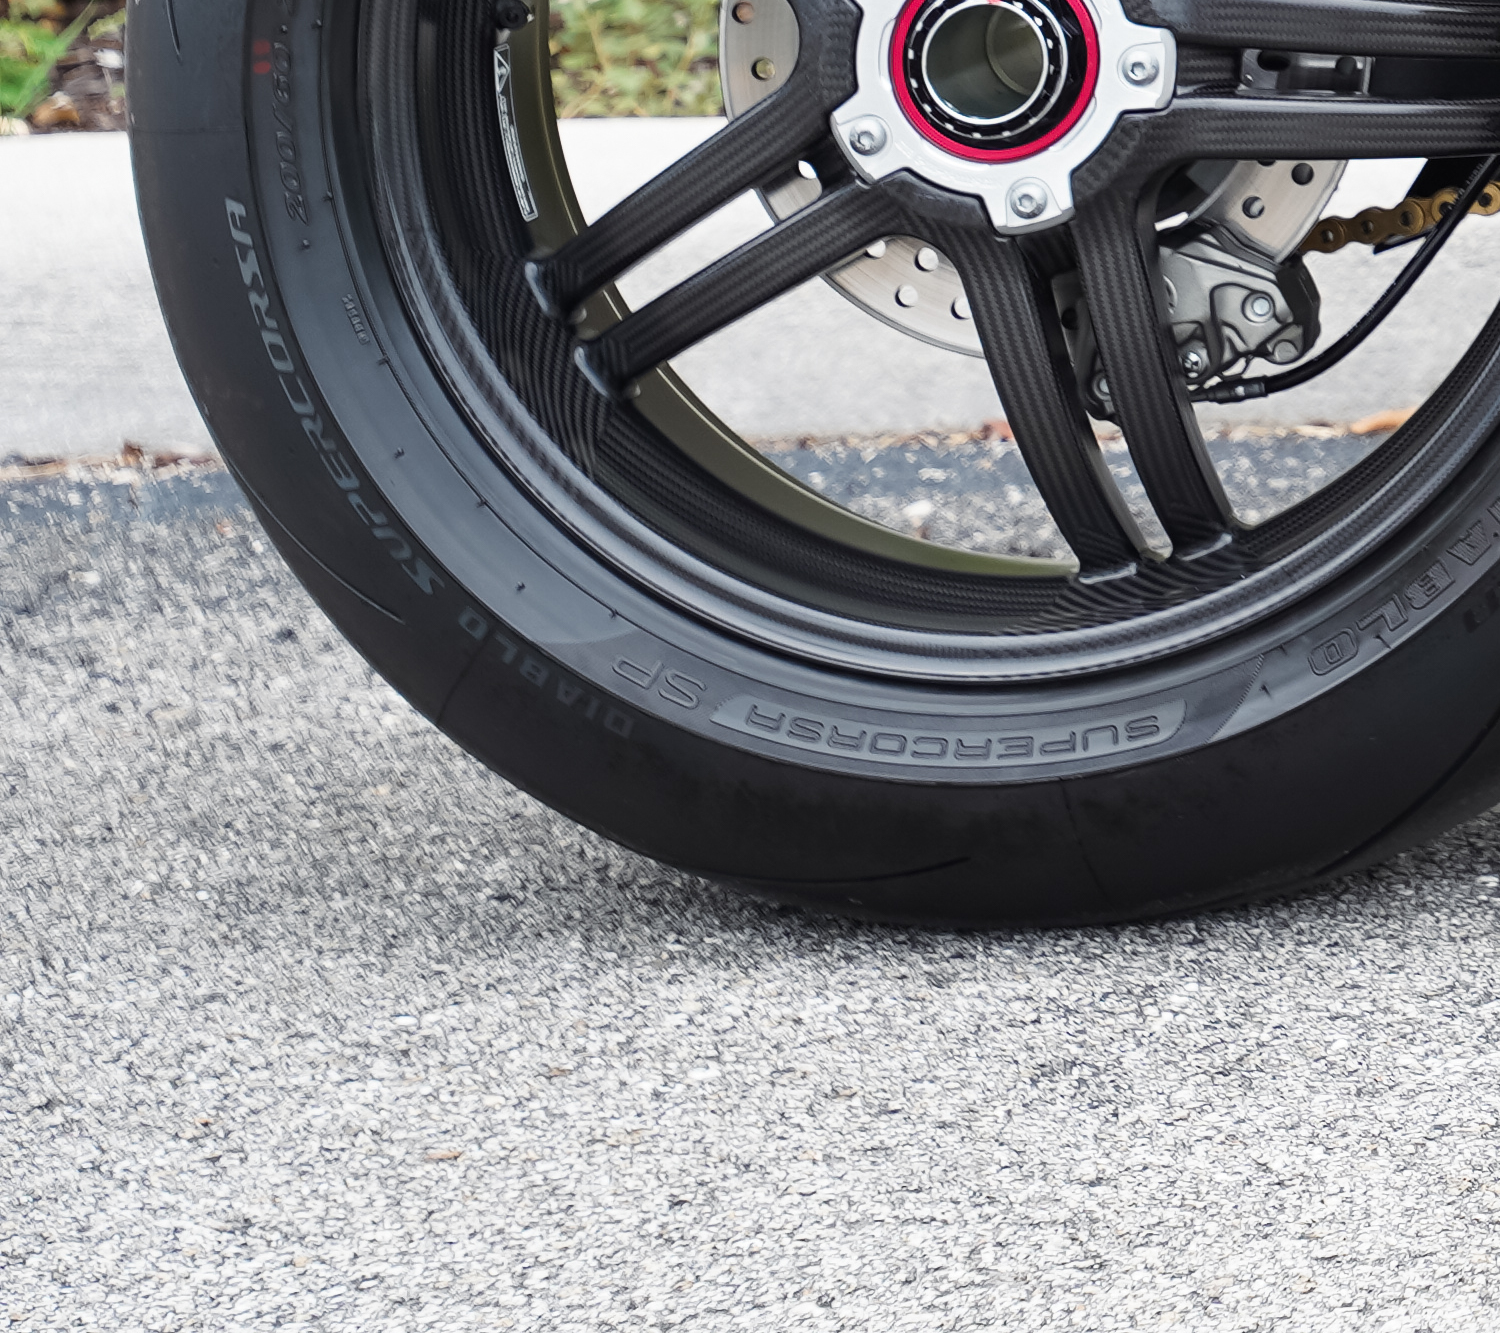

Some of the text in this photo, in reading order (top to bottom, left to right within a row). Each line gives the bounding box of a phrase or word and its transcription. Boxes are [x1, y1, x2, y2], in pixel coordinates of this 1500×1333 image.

[219, 192, 447, 601] SUPERCORSA
[452, 598, 638, 744] DIABLO
[603, 634, 1167, 772] SUPERCORSA SP
